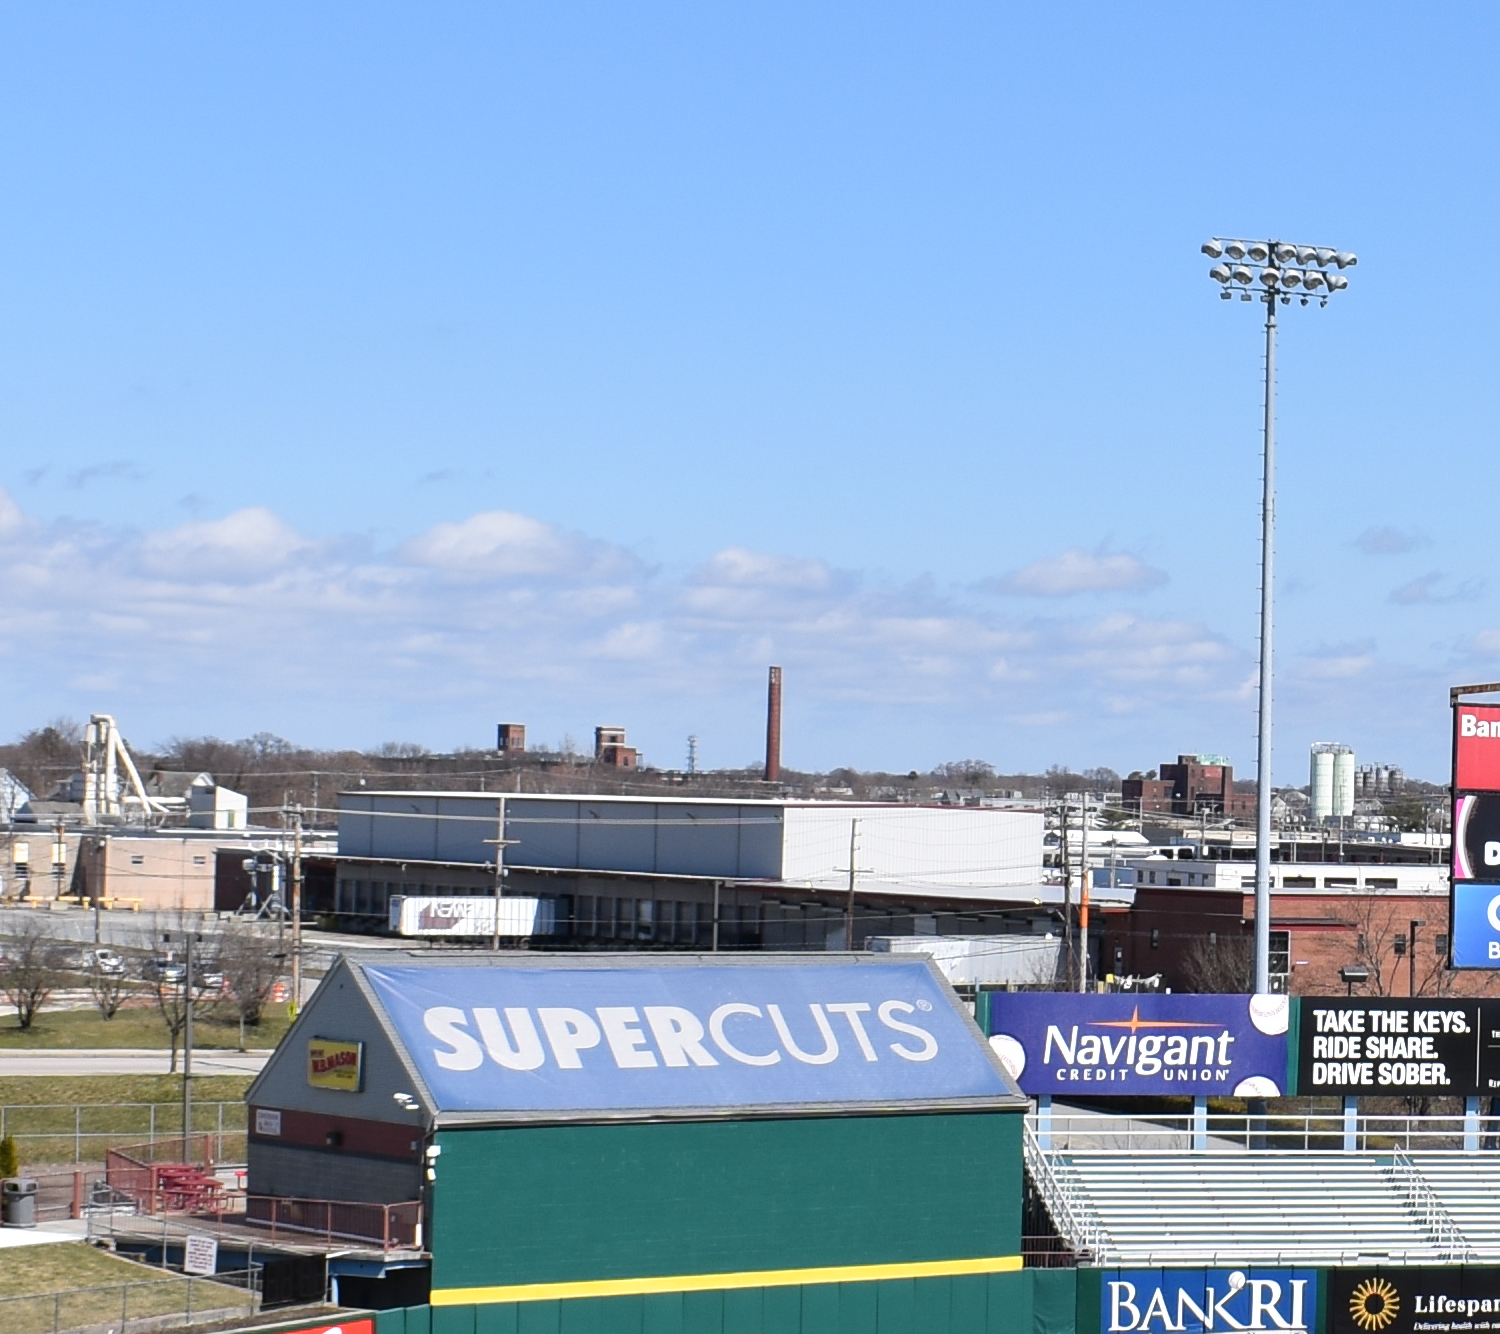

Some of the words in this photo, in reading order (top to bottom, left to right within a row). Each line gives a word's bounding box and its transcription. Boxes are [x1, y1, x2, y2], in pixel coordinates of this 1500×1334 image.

[1313, 1010, 1364, 1033] TAKE
[1369, 1010, 1409, 1033] THE
[1413, 1011, 1470, 1033] KEYS.
[423, 1001, 939, 1071] SUPERCUTS
[1042, 1025, 1235, 1076] Navigant
[1313, 1037, 1362, 1059] RIDE
[1366, 1037, 1438, 1059] SHARE.
[1056, 1068, 1129, 1082] CREDIT
[1162, 1069, 1226, 1081] UNION
[1313, 1063, 1374, 1085] DRIVE
[1378, 1063, 1450, 1086] SOBER.
